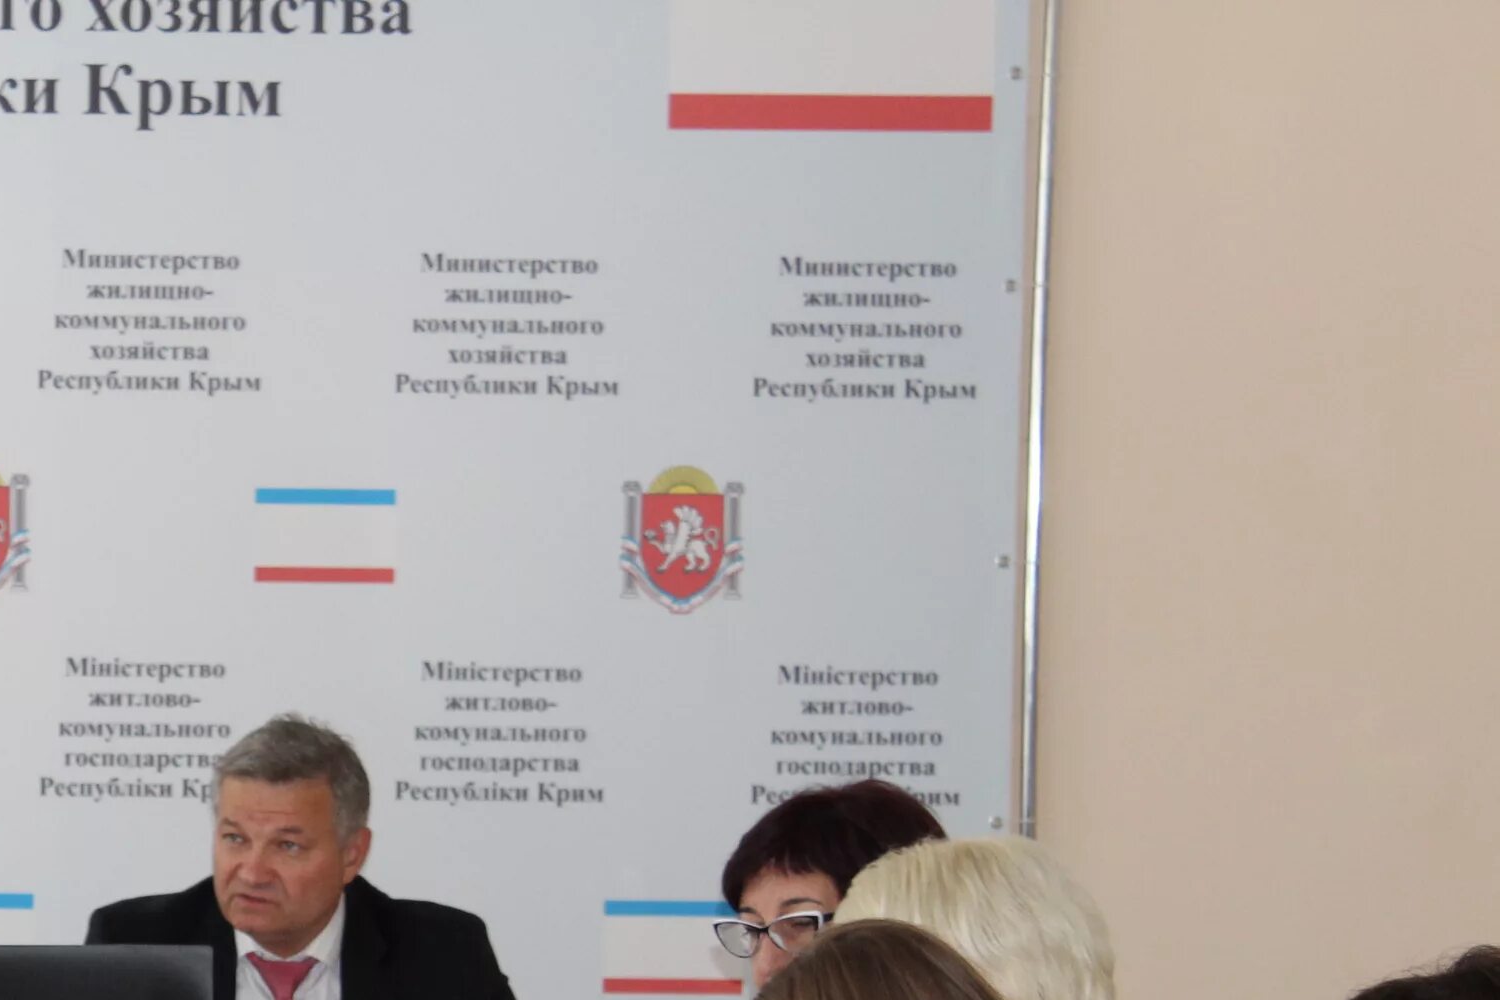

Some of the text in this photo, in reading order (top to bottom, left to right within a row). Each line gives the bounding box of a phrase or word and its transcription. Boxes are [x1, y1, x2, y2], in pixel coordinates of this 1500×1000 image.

[83, 63, 282, 132] Крым
[63, 248, 241, 276] Министерство
[421, 252, 599, 279] Министерство
[780, 256, 958, 283] Министерство
[86, 284, 214, 301] жилищно-
[445, 288, 572, 305] жилищно-
[803, 292, 931, 308] жилищно-
[54, 314, 247, 335] коммунального
[412, 318, 605, 339] коммунального
[770, 322, 963, 343] коммунального
[90, 341, 210, 361] хозяйства
[448, 346, 567, 365] хозяйства
[806, 350, 925, 369] хозяйства
[38, 369, 261, 397] Республики Крым
[395, 373, 619, 401] Республики Крым
[753, 377, 977, 405] Республики Крым
[66, 656, 226, 684] Міністерство
[423, 661, 583, 687] Міністерство
[779, 664, 939, 691] Міністерство
[89, 692, 201, 708] житлово-
[445, 696, 557, 712] житлово-
[801, 700, 913, 716] житлово-
[59, 722, 231, 743] комунального
[414, 726, 587, 747] комунального
[771, 730, 943, 750] комунального
[420, 756, 580, 777] господарства
[776, 760, 936, 780] господарства
[40, 776, 214, 804] Республіки Кр
[395, 780, 604, 808] Республіки Крим
